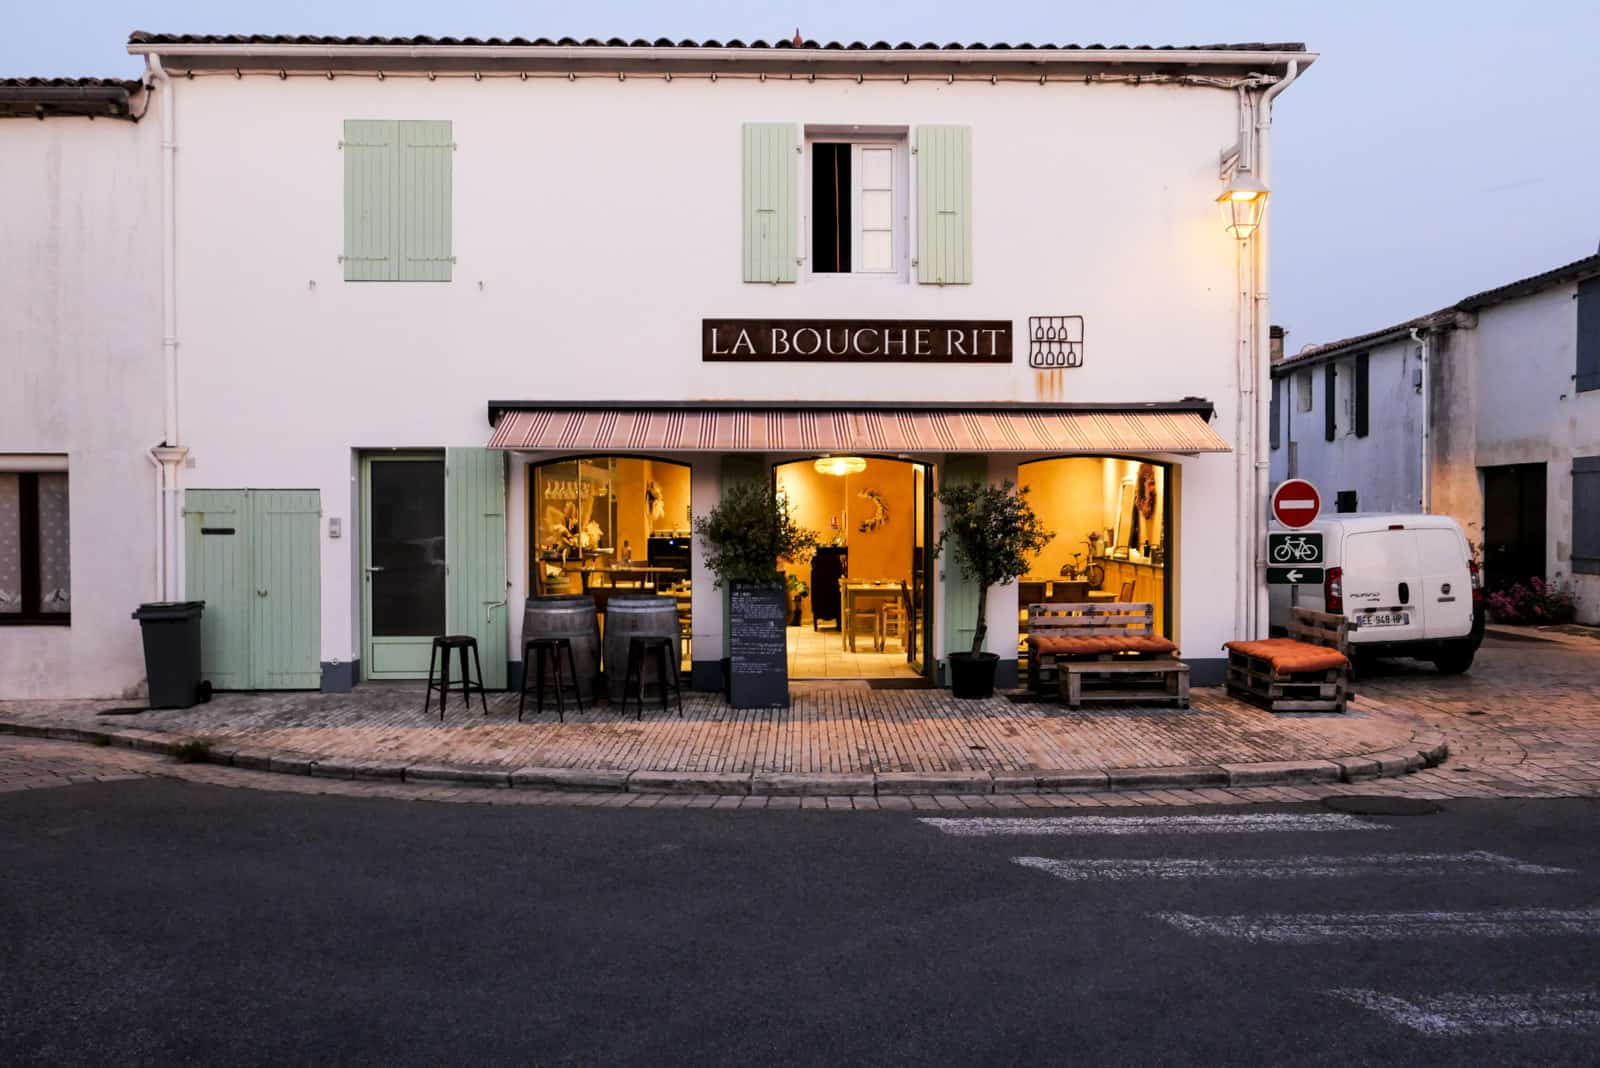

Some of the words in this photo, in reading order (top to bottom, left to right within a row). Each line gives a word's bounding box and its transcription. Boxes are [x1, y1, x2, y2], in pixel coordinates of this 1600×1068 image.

[711, 327, 757, 355] LA
[770, 327, 932, 356] BOUCHE
[946, 329, 1006, 356] RIT
